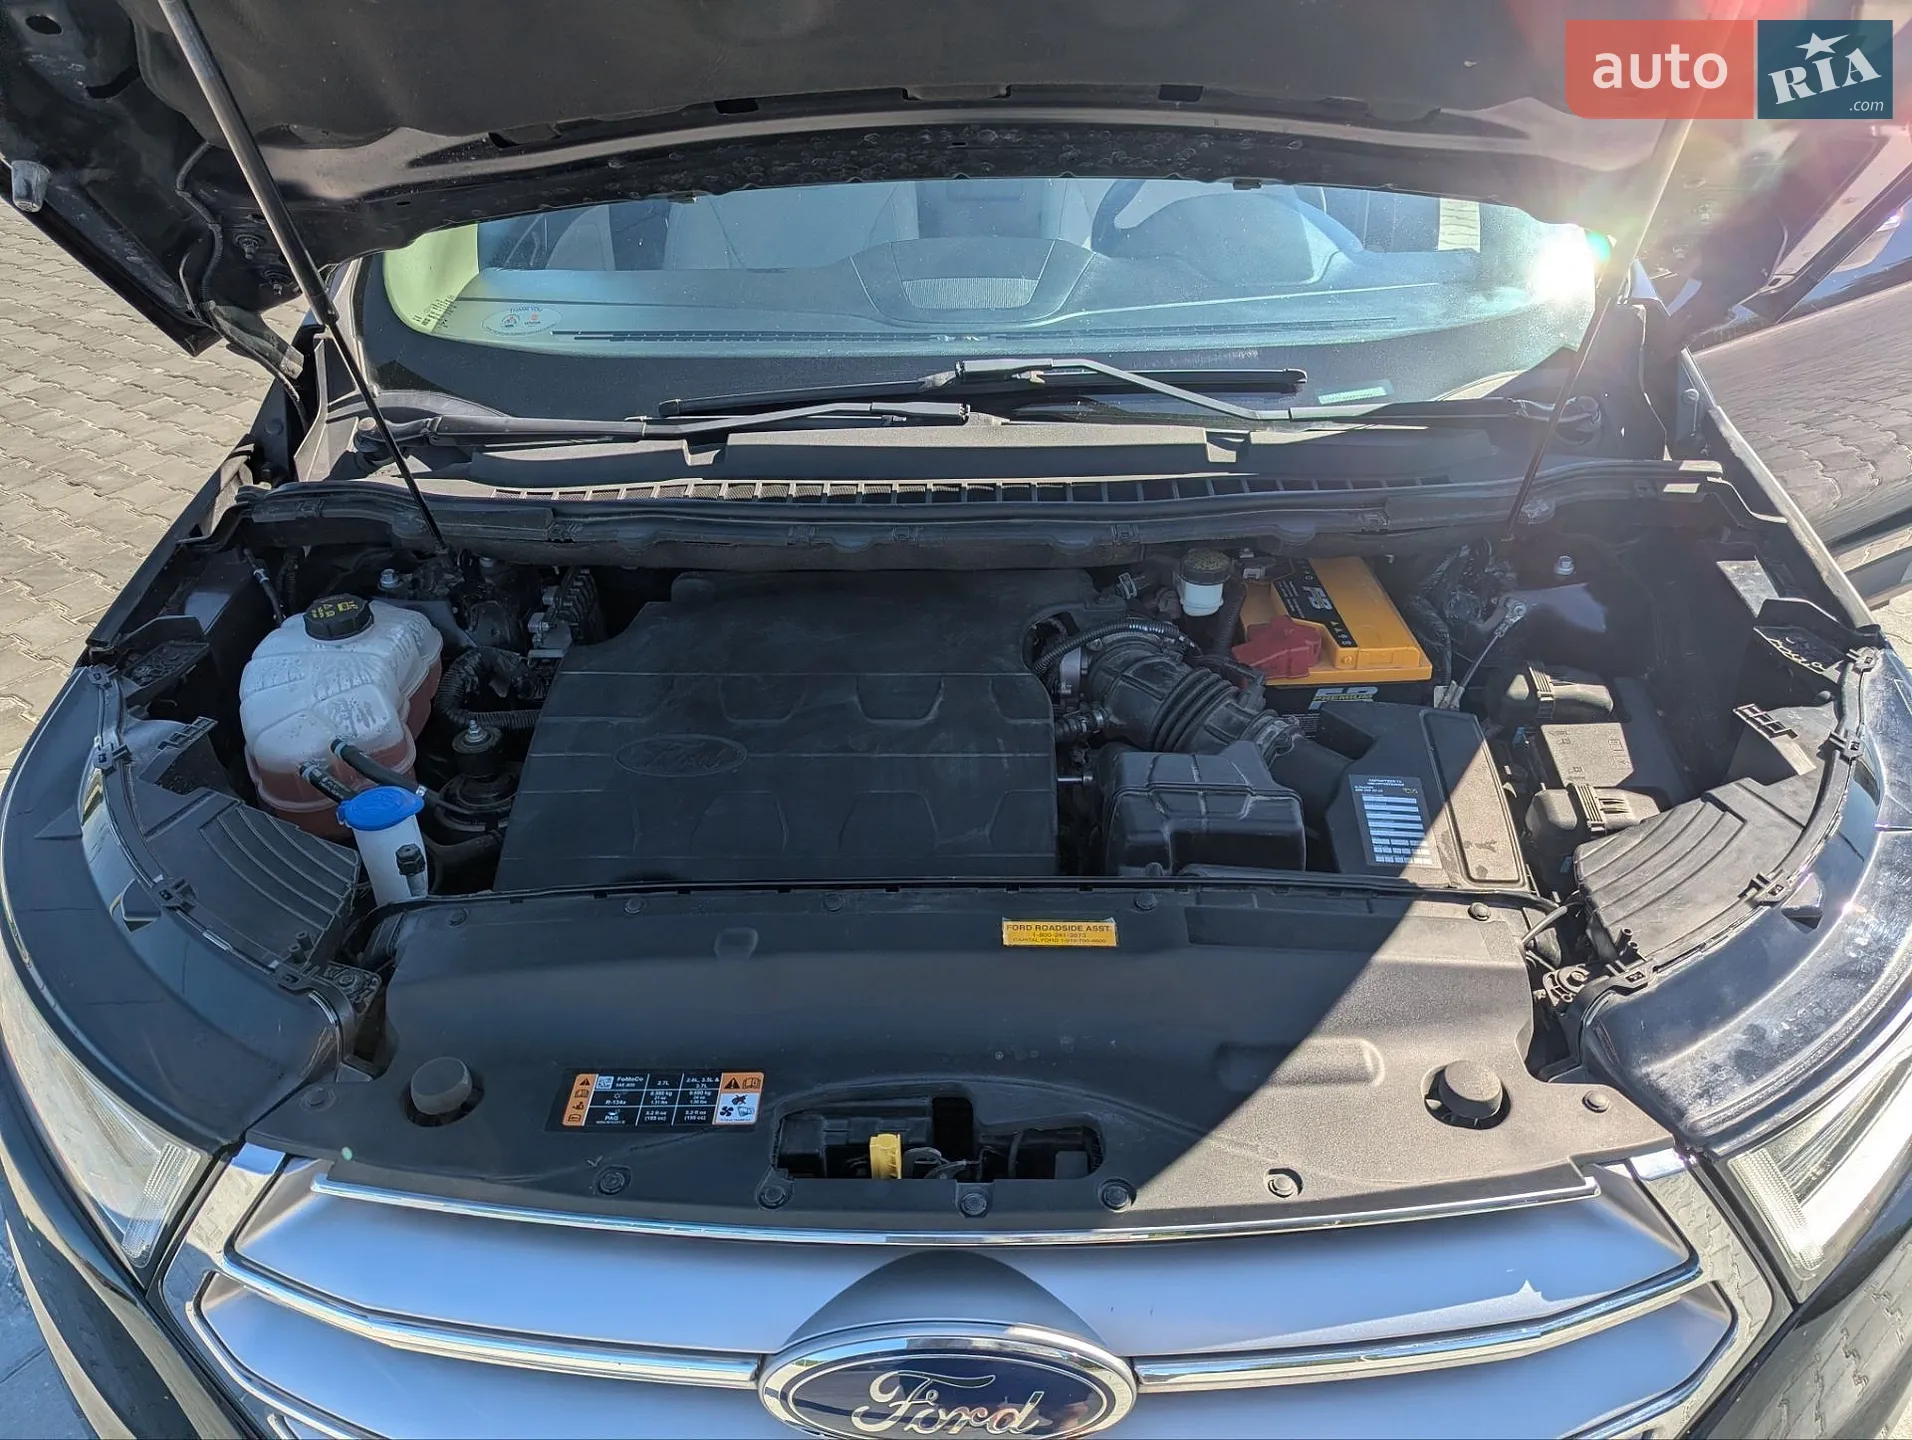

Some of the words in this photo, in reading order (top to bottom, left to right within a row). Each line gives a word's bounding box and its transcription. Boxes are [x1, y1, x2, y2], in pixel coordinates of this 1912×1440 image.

[1313, 693, 1373, 701] PREMIUM
[1035, 924, 1084, 932] ROADSIDE
[851, 1369, 1043, 1435] Ford
